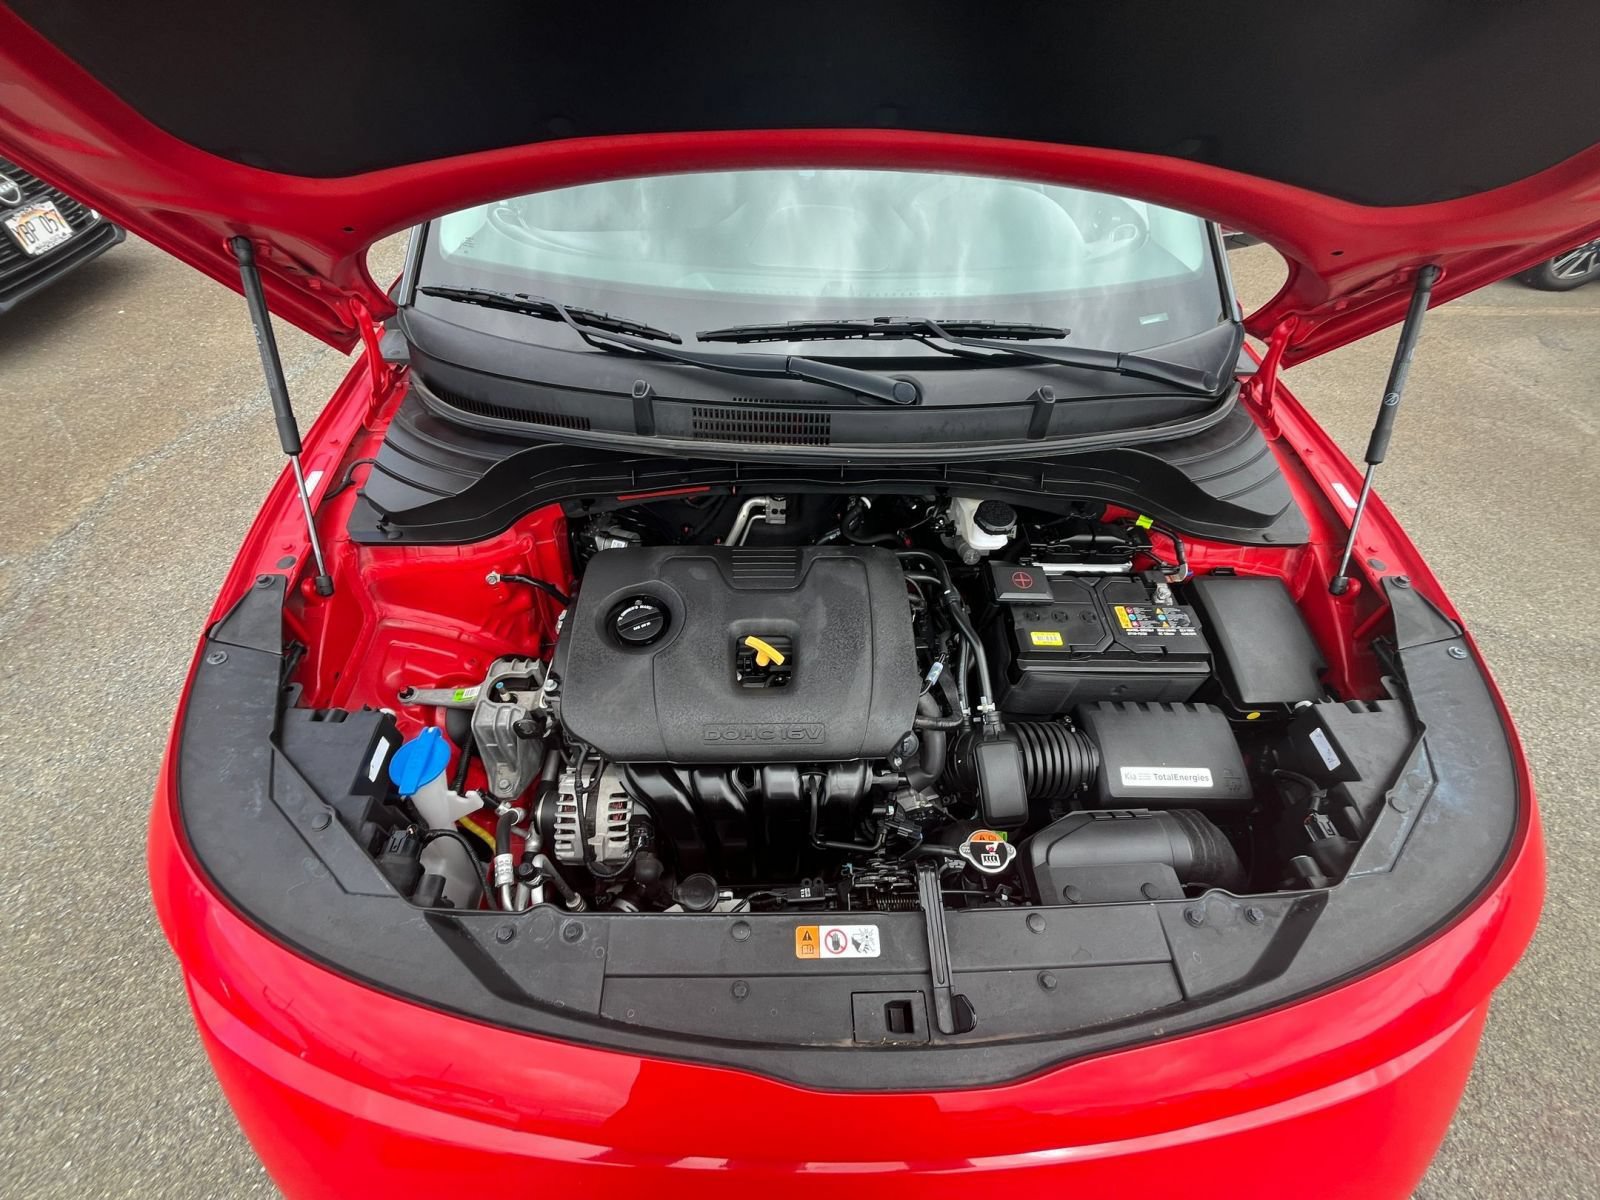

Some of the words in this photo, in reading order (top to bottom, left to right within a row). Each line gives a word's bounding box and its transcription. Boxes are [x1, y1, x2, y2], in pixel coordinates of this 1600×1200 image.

[39, 208, 66, 234] 057
[704, 728, 777, 741] DOHC
[781, 727, 823, 740] 16V
[1153, 773, 1210, 783] TotalEnergies
